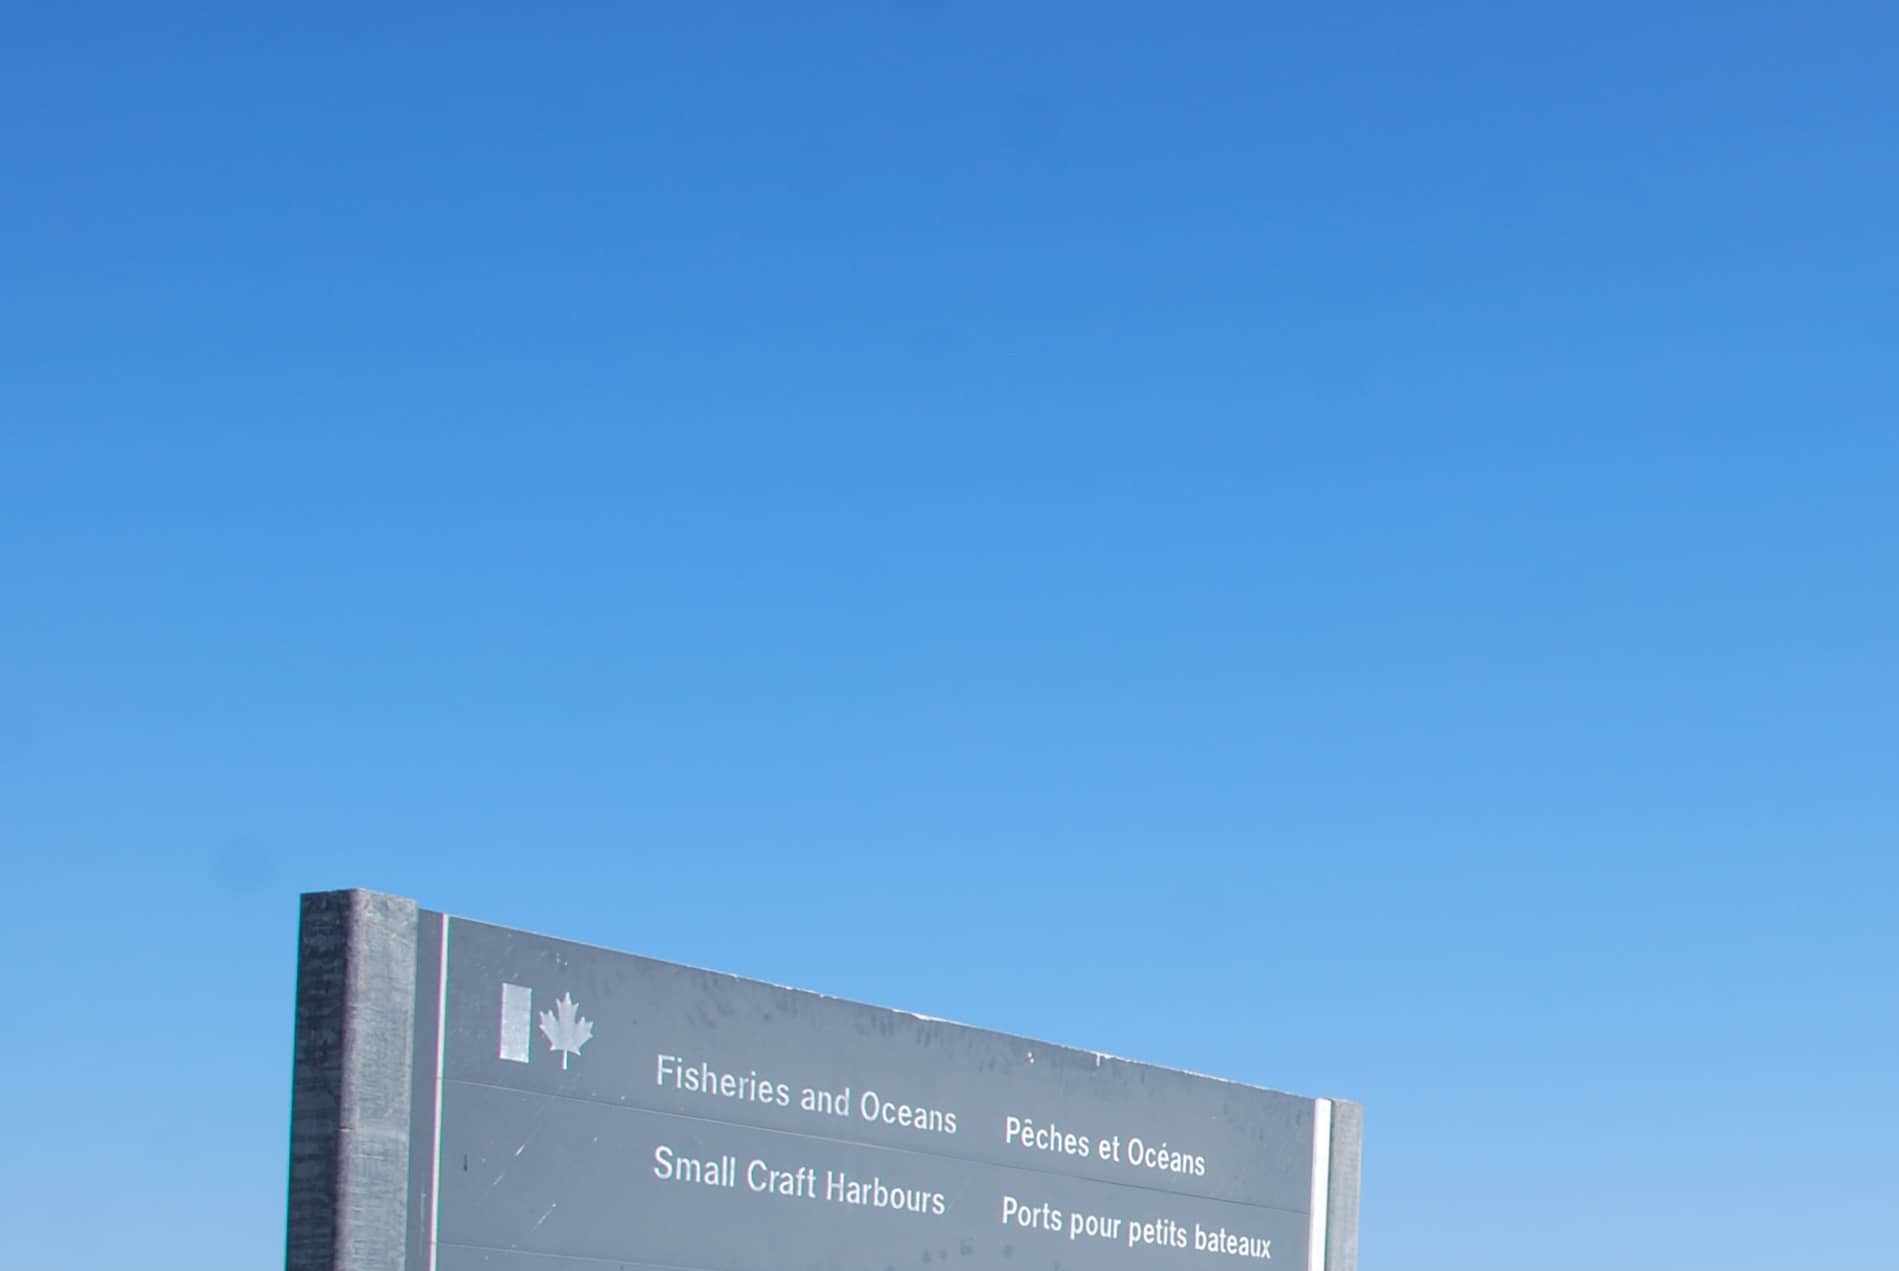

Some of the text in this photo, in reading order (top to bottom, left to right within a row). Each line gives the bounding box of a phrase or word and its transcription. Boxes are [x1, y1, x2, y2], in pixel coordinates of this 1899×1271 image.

[656, 1054, 957, 1134] Fisheries and Oceans
[1005, 1115, 1206, 1177] Pêches et Océans
[653, 1145, 945, 1215] Small Craft Harbours
[1001, 1195, 1272, 1260] Ports pour petits bateaux
